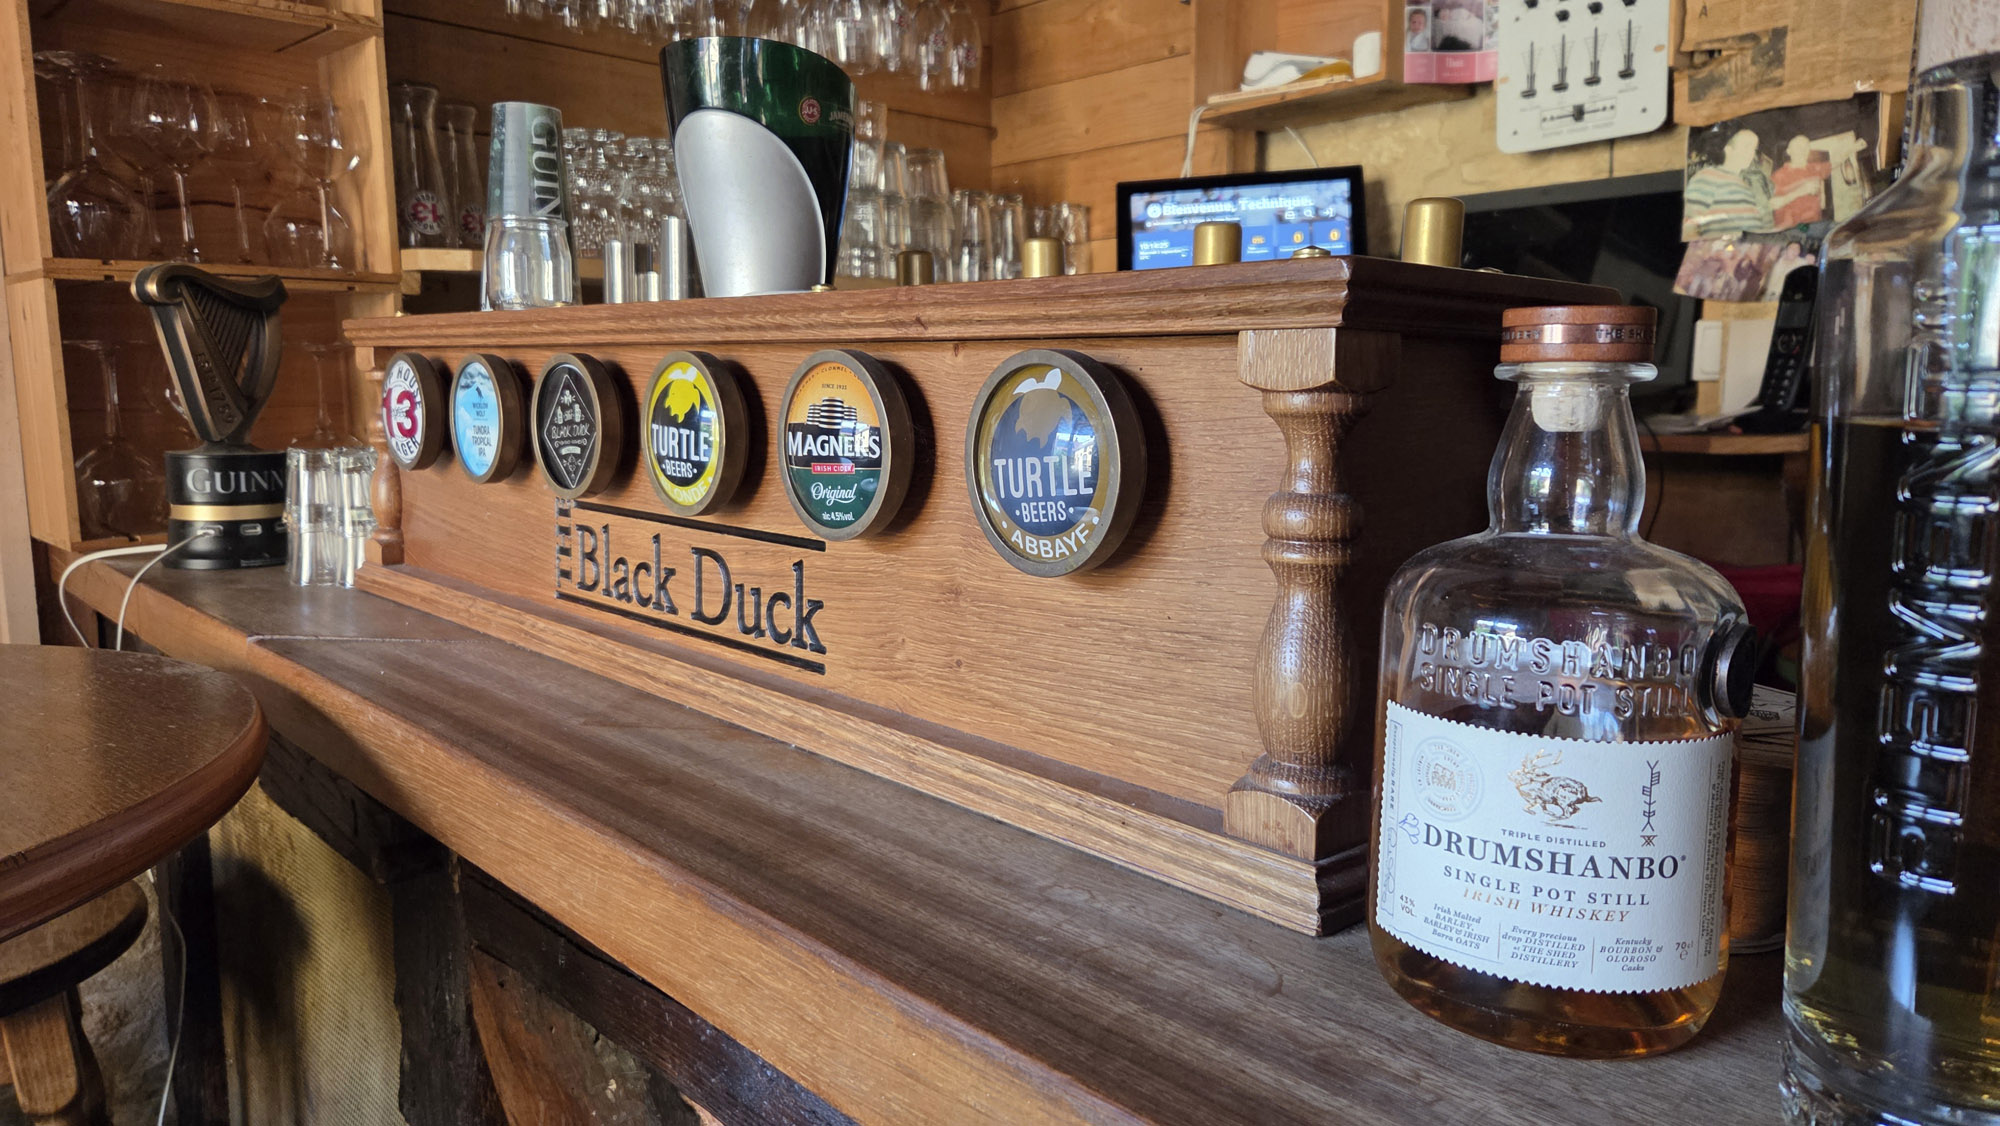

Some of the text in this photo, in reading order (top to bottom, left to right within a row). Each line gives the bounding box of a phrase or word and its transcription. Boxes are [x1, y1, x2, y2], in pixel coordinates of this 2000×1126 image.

[1595, 328, 1625, 339] THE
[383, 387, 419, 438] 13
[473, 425, 490, 435] TUNDRA
[395, 435, 420, 456] AGER
[472, 435, 491, 446] TROPICAL
[652, 424, 711, 462] TURTLE
[788, 431, 881, 459] MAGNERS
[478, 447, 486, 457] IPA
[665, 460, 693, 478] BEERS
[994, 456, 1094, 499] TURTLE
[811, 482, 857, 506] Original
[1021, 500, 1067, 523] BEERS
[575, 523, 827, 655] Black Duck
[1420, 622, 1697, 680] DRUMSHANBO
[1419, 661, 1690, 721] SINGLE POT STILL
[1501, 828, 1607, 848] TRIPLE DISTILLED
[1423, 822, 1680, 880] DRUMSHANBO
[1443, 865, 1650, 906] SINGLE POT STILL
[1434, 903, 1482, 924] Irish Malted
[1463, 887, 1631, 922] IRISH WHISKEY
[1423, 916, 1455, 933] BARLEY
[1463, 930, 1490, 944] IRISH
[1512, 925, 1577, 943] Every precious
[1455, 937, 1481, 950] OATS
[1501, 932, 1586, 952] drop DISTILLED
[1600, 945, 1651, 954] BOURBON
[1615, 936, 1653, 946] Kentucky
[1511, 951, 1578, 968] DISTILLERY
[1522, 945, 1544, 955] THE
[1546, 949, 1576, 959] SHED
[1606, 955, 1657, 963] OLOROSO
[1621, 963, 1645, 972] Casks
